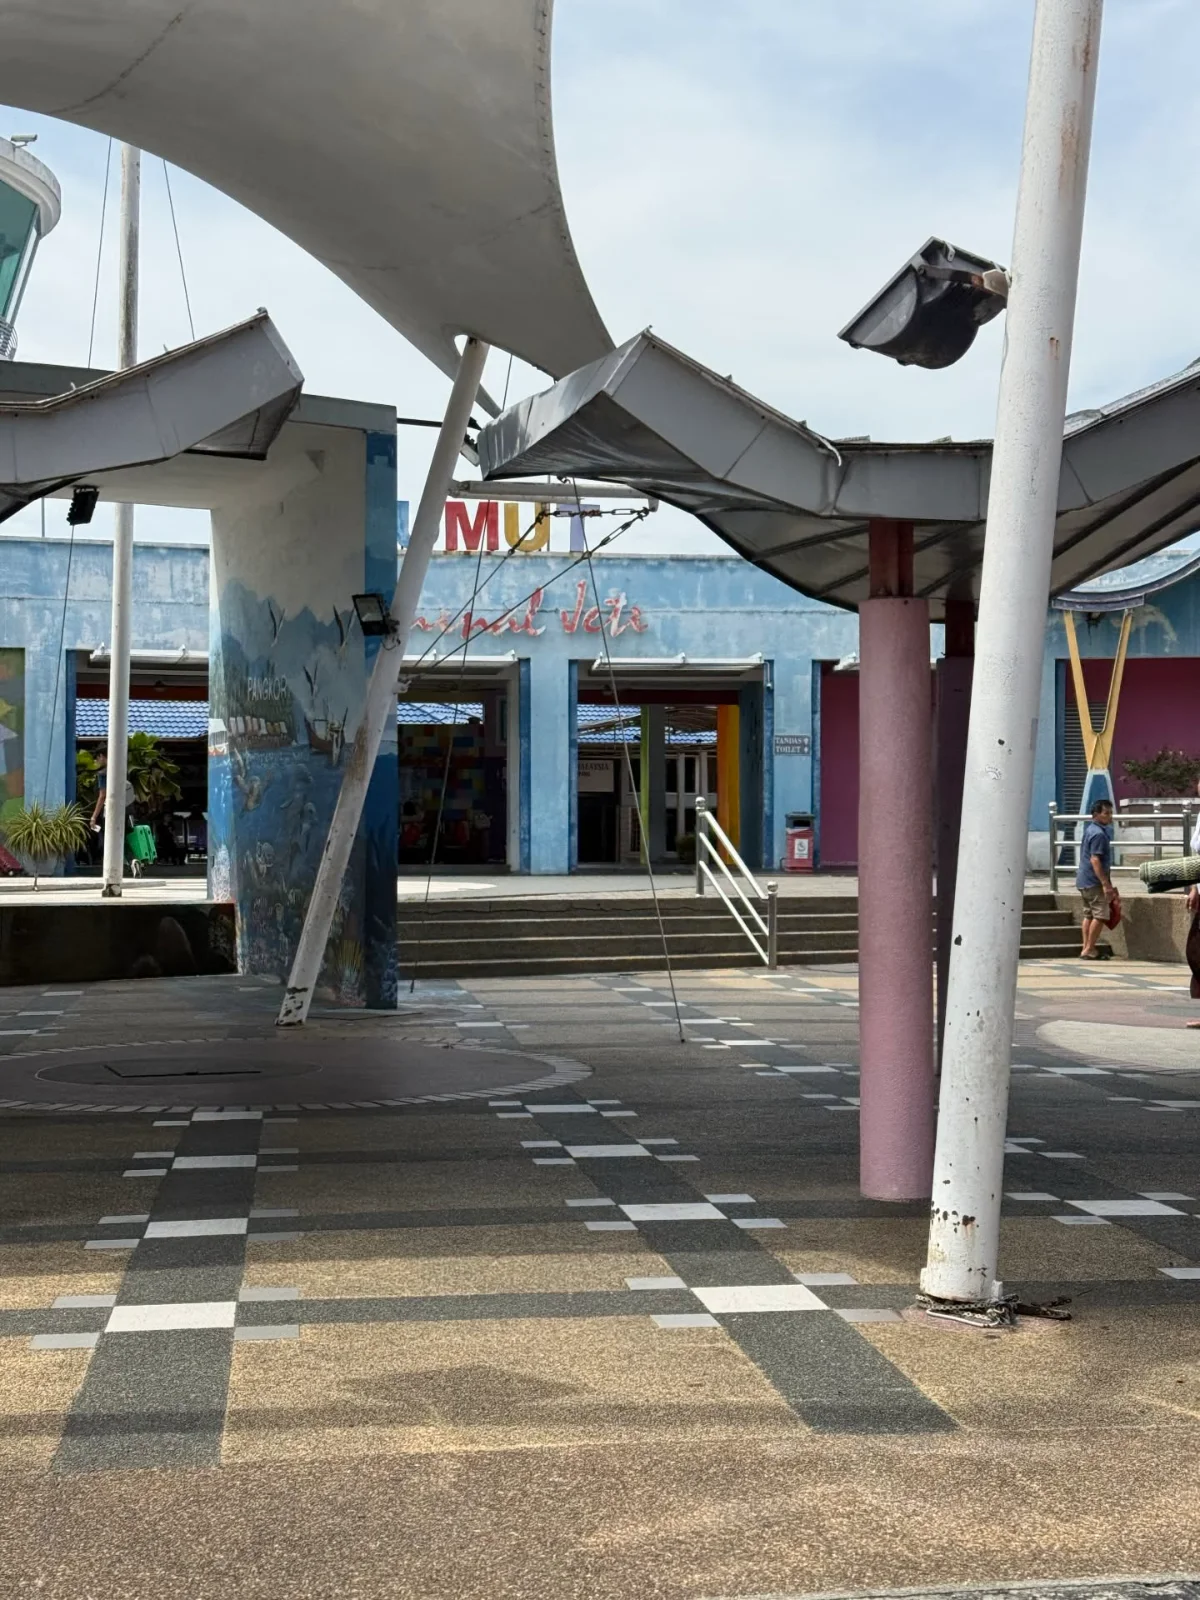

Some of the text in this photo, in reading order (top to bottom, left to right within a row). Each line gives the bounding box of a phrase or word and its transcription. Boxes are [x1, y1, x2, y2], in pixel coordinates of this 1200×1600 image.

[247, 674, 288, 701] PANGKOR
[775, 736, 802, 745] TANDAS
[775, 745, 801, 753] TOILET
